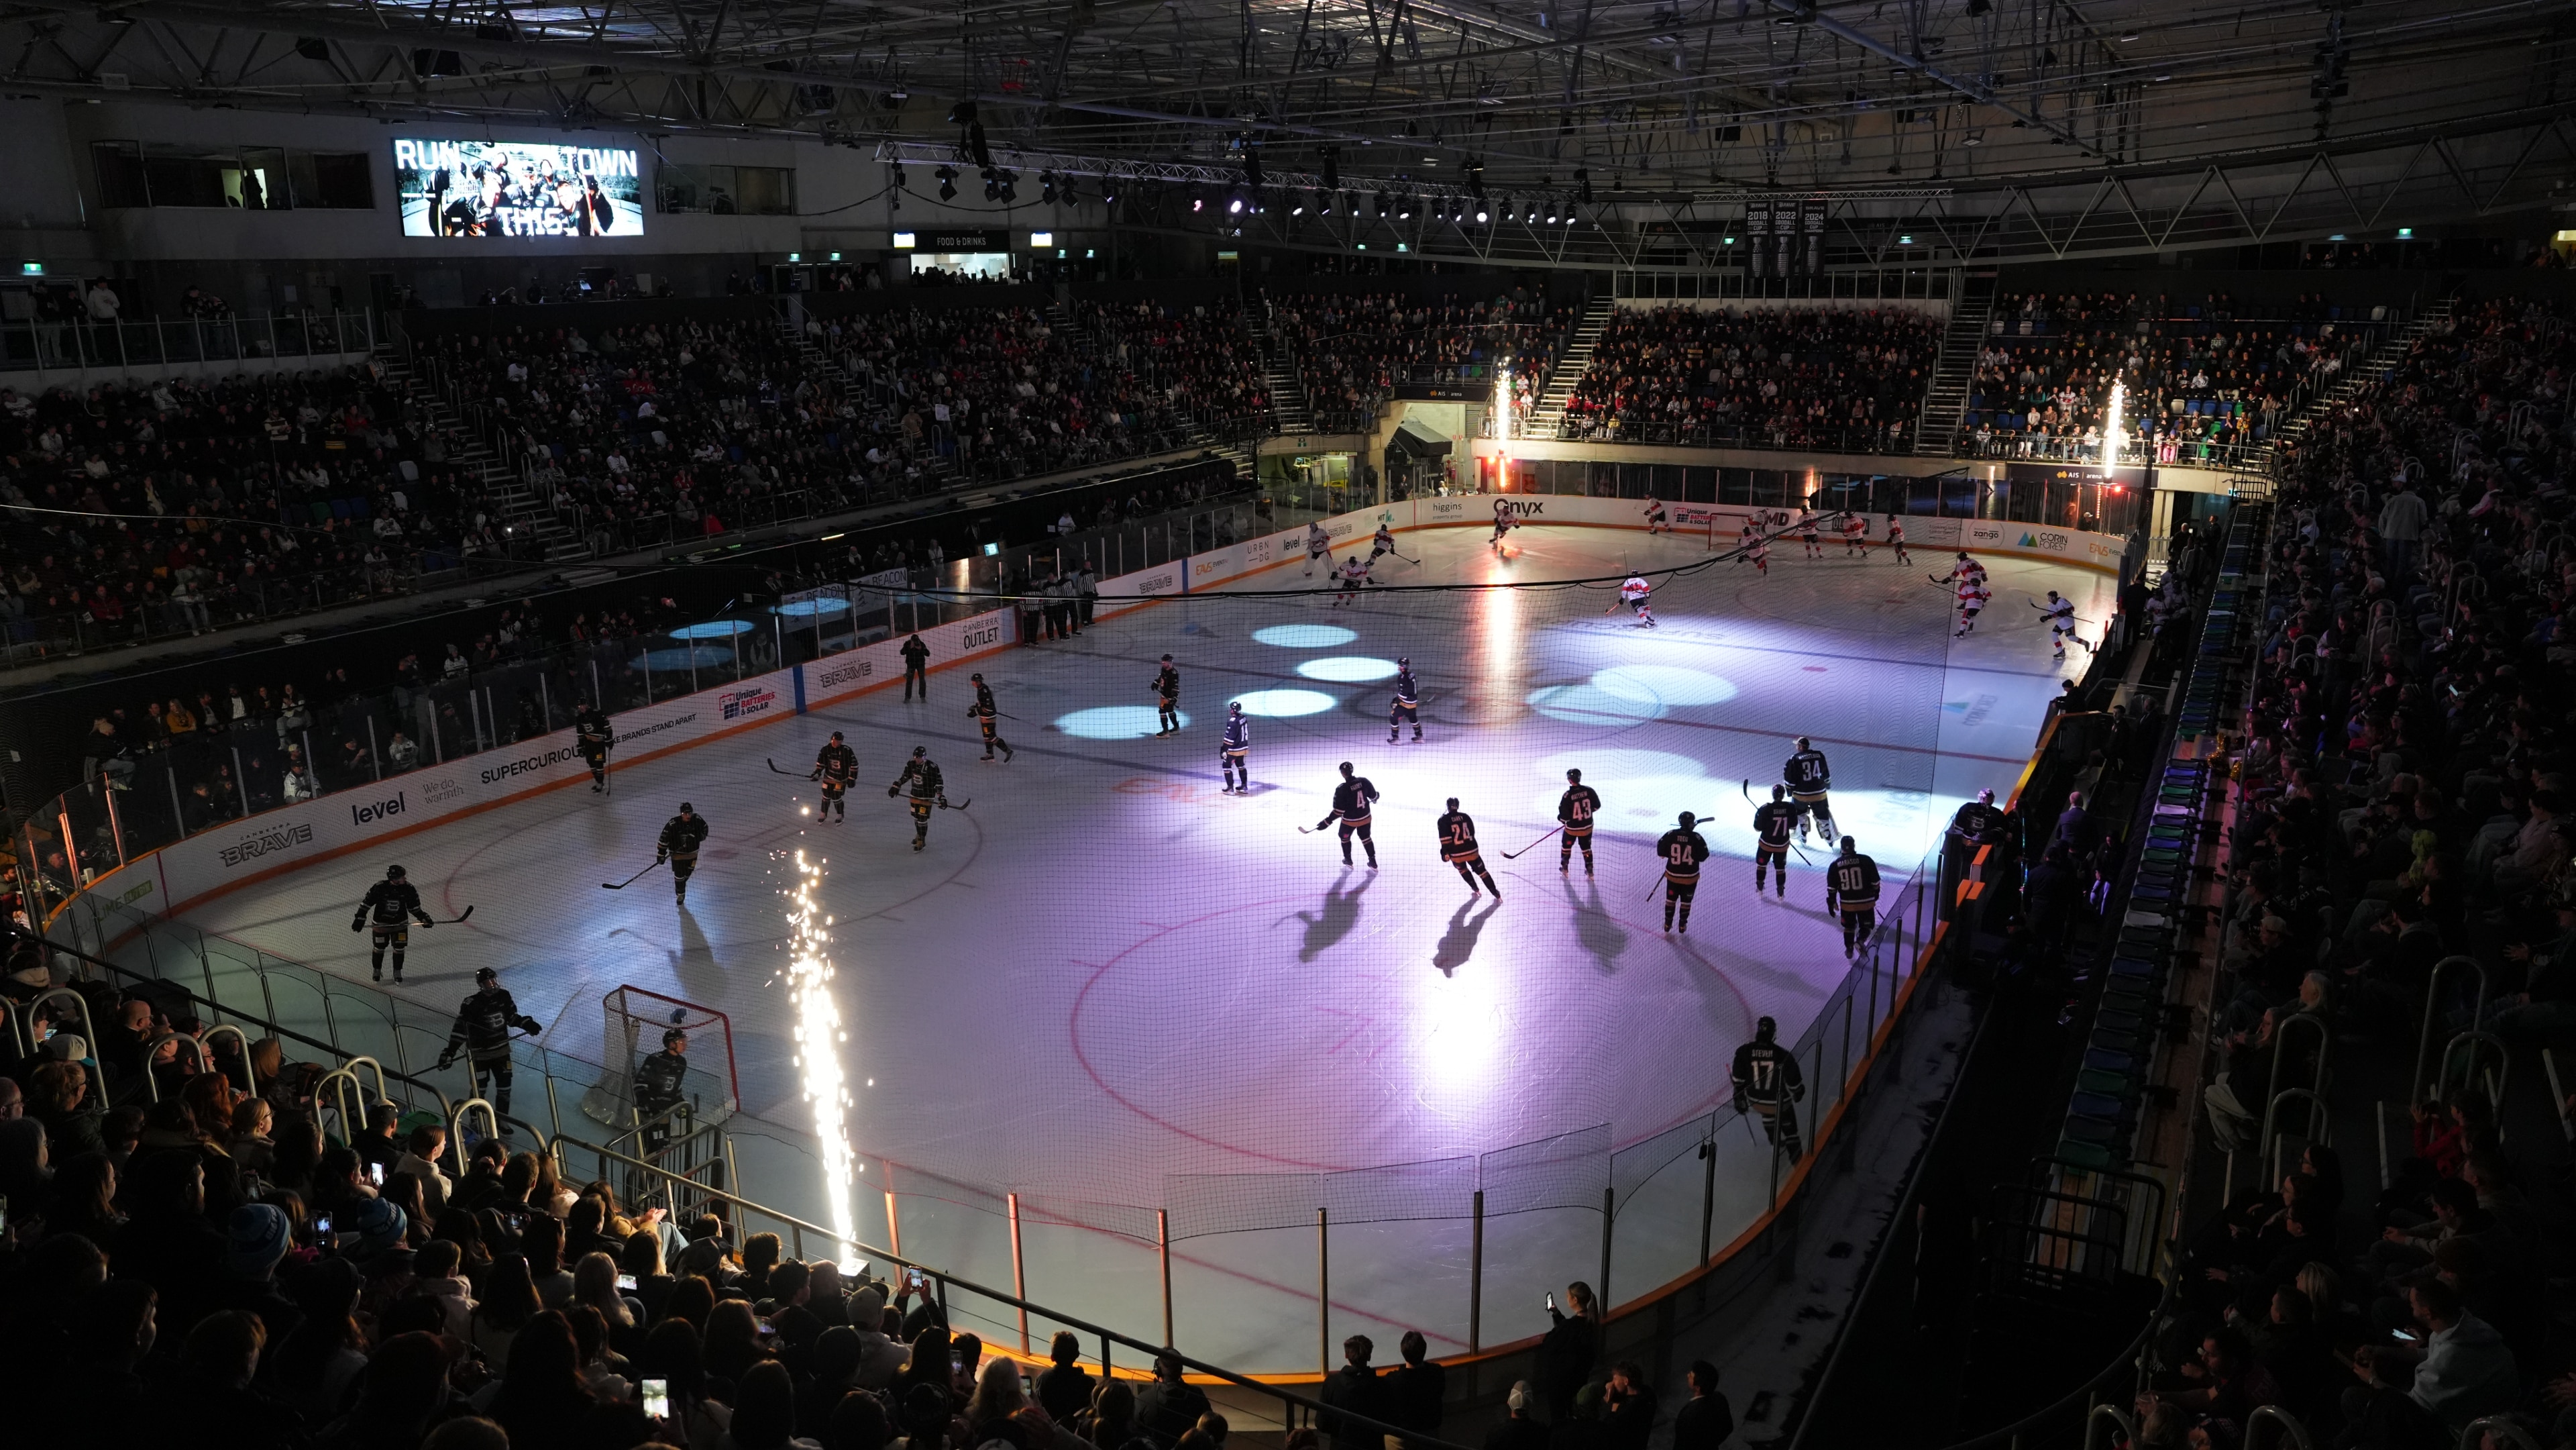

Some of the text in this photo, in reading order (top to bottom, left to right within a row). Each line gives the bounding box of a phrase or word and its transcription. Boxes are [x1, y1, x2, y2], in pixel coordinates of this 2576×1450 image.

[395, 140, 638, 177] RUN TOWN
[1748, 211, 1768, 220] 2018
[1776, 211, 1796, 219] 2022
[936, 237, 986, 246] FOOD & DRINKS
[1433, 503, 1462, 512] higgins
[1493, 498, 1544, 517] Onyx
[1283, 536, 1300, 551] level
[1974, 530, 1999, 539] zango
[2040, 532, 2068, 544] CORIN
[1247, 541, 1269, 554] URBN
[2039, 540, 2068, 552] FOREST
[873, 570, 906, 586] BEACON
[1139, 575, 1173, 594] BRAVE
[806, 584, 845, 601] BEACON
[963, 617, 998, 633] CANBERRA
[964, 627, 998, 649] OUTLET
[820, 662, 872, 688] BRAVE
[735, 688, 762, 701] Unique
[741, 692, 775, 707] BATTERIES
[747, 702, 769, 714] SOLAR
[481, 745, 583, 784] SUPERCURIOU
[622, 727, 651, 743] BRANDS
[651, 720, 675, 734] STAND
[675, 713, 697, 729] APART
[1802, 760, 1822, 781] 34
[423, 778, 455, 794] We do
[425, 786, 464, 805] warmth
[1357, 790, 1366, 809] 4
[352, 792, 406, 825] level
[1572, 798, 1591, 821] 43
[240, 822, 291, 841] CANBERRA
[1451, 822, 1473, 845] 24
[1772, 817, 1788, 836] 71
[219, 824, 313, 867] BRAVE
[1677, 835, 1688, 843] TODD
[1670, 843, 1695, 866] 94
[1837, 858, 1860, 868] MARASCO
[1838, 866, 1863, 891] 90
[1750, 1060, 1775, 1090] 17
